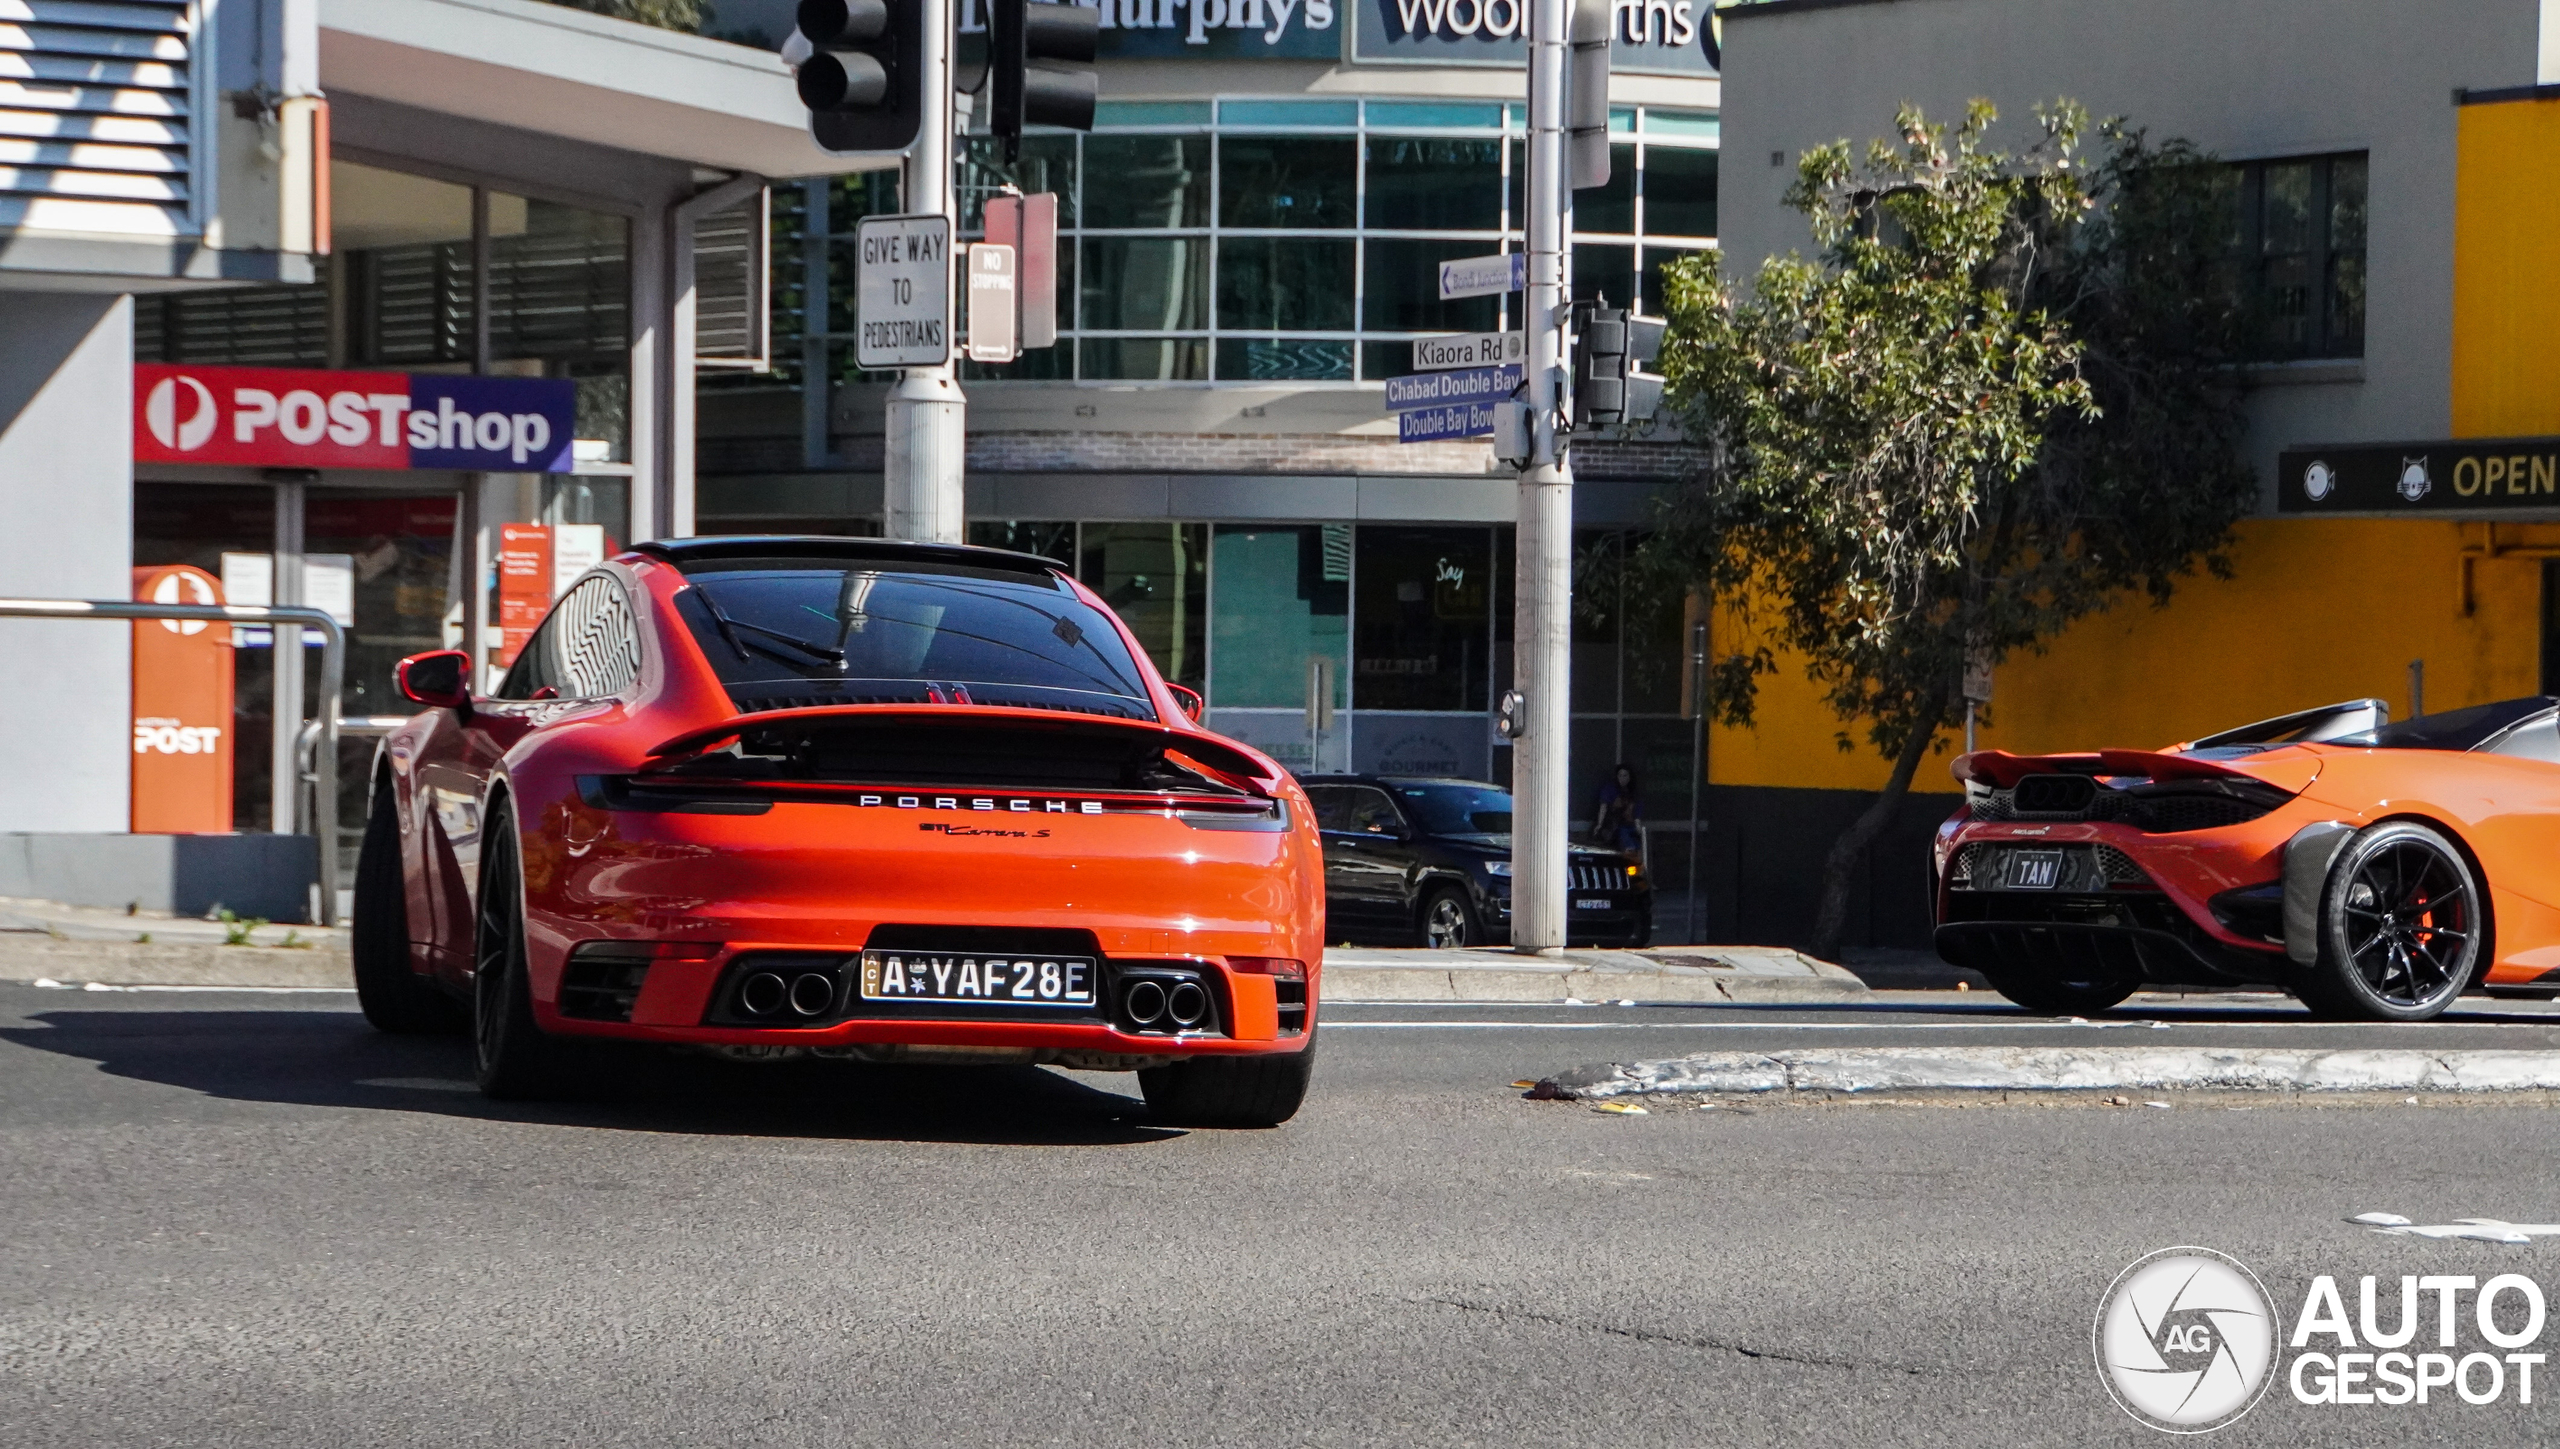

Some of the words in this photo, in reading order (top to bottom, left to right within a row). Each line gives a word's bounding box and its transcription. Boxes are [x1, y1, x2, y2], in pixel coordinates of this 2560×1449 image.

[864, 236, 900, 264] GIVE
[906, 234, 944, 262] WAY
[983, 252, 1002, 271] NO
[892, 278, 912, 305] TO
[972, 274, 1013, 291] STOPPING
[864, 319, 941, 348] PEDESTRIANS
[1418, 341, 1473, 365] Kiaora
[1481, 338, 1503, 361] Rd
[1389, 376, 1438, 402] Chabad
[1441, 372, 1490, 396] Double
[1404, 411, 1444, 436] Double
[1447, 408, 1468, 435] Bay
[2453, 453, 2557, 497] OPEN
[1436, 557, 1464, 590] Say
[134, 726, 221, 754] POST
[860, 795, 1103, 814] PORSCHE
[1032, 829, 1051, 837] S
[2019, 861, 2052, 884] TAN
